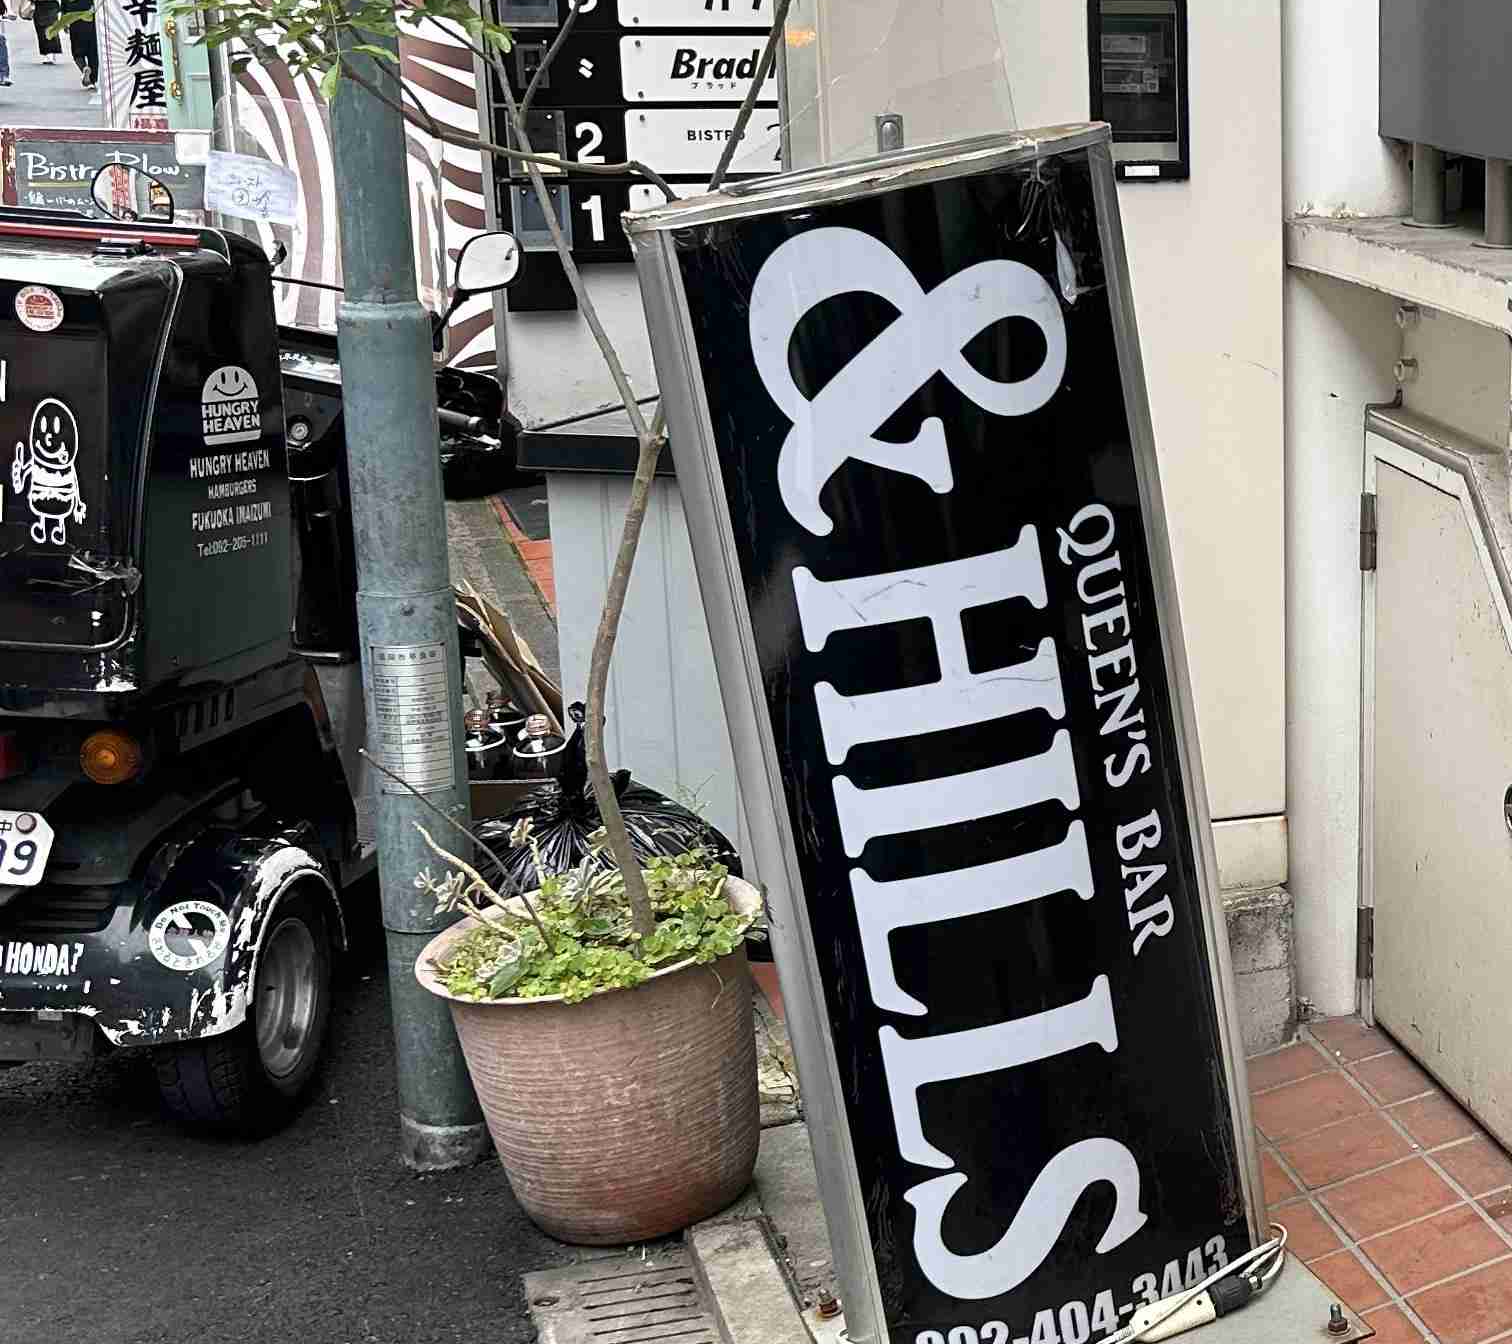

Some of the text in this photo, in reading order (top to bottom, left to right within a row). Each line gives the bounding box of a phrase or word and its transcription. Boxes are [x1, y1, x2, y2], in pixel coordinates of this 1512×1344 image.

[575, 122, 606, 164] 2
[581, 195, 604, 242] 1
[201, 400, 259, 419] HUNGRY
[203, 414, 261, 434] HEAVEN
[189, 449, 270, 479] HUNGRY HEAVEN
[192, 507, 235, 532] FUKUOKA
[1056, 503, 1175, 957] QUEEN'S BAR
[5, 941, 85, 976] HONDA?
